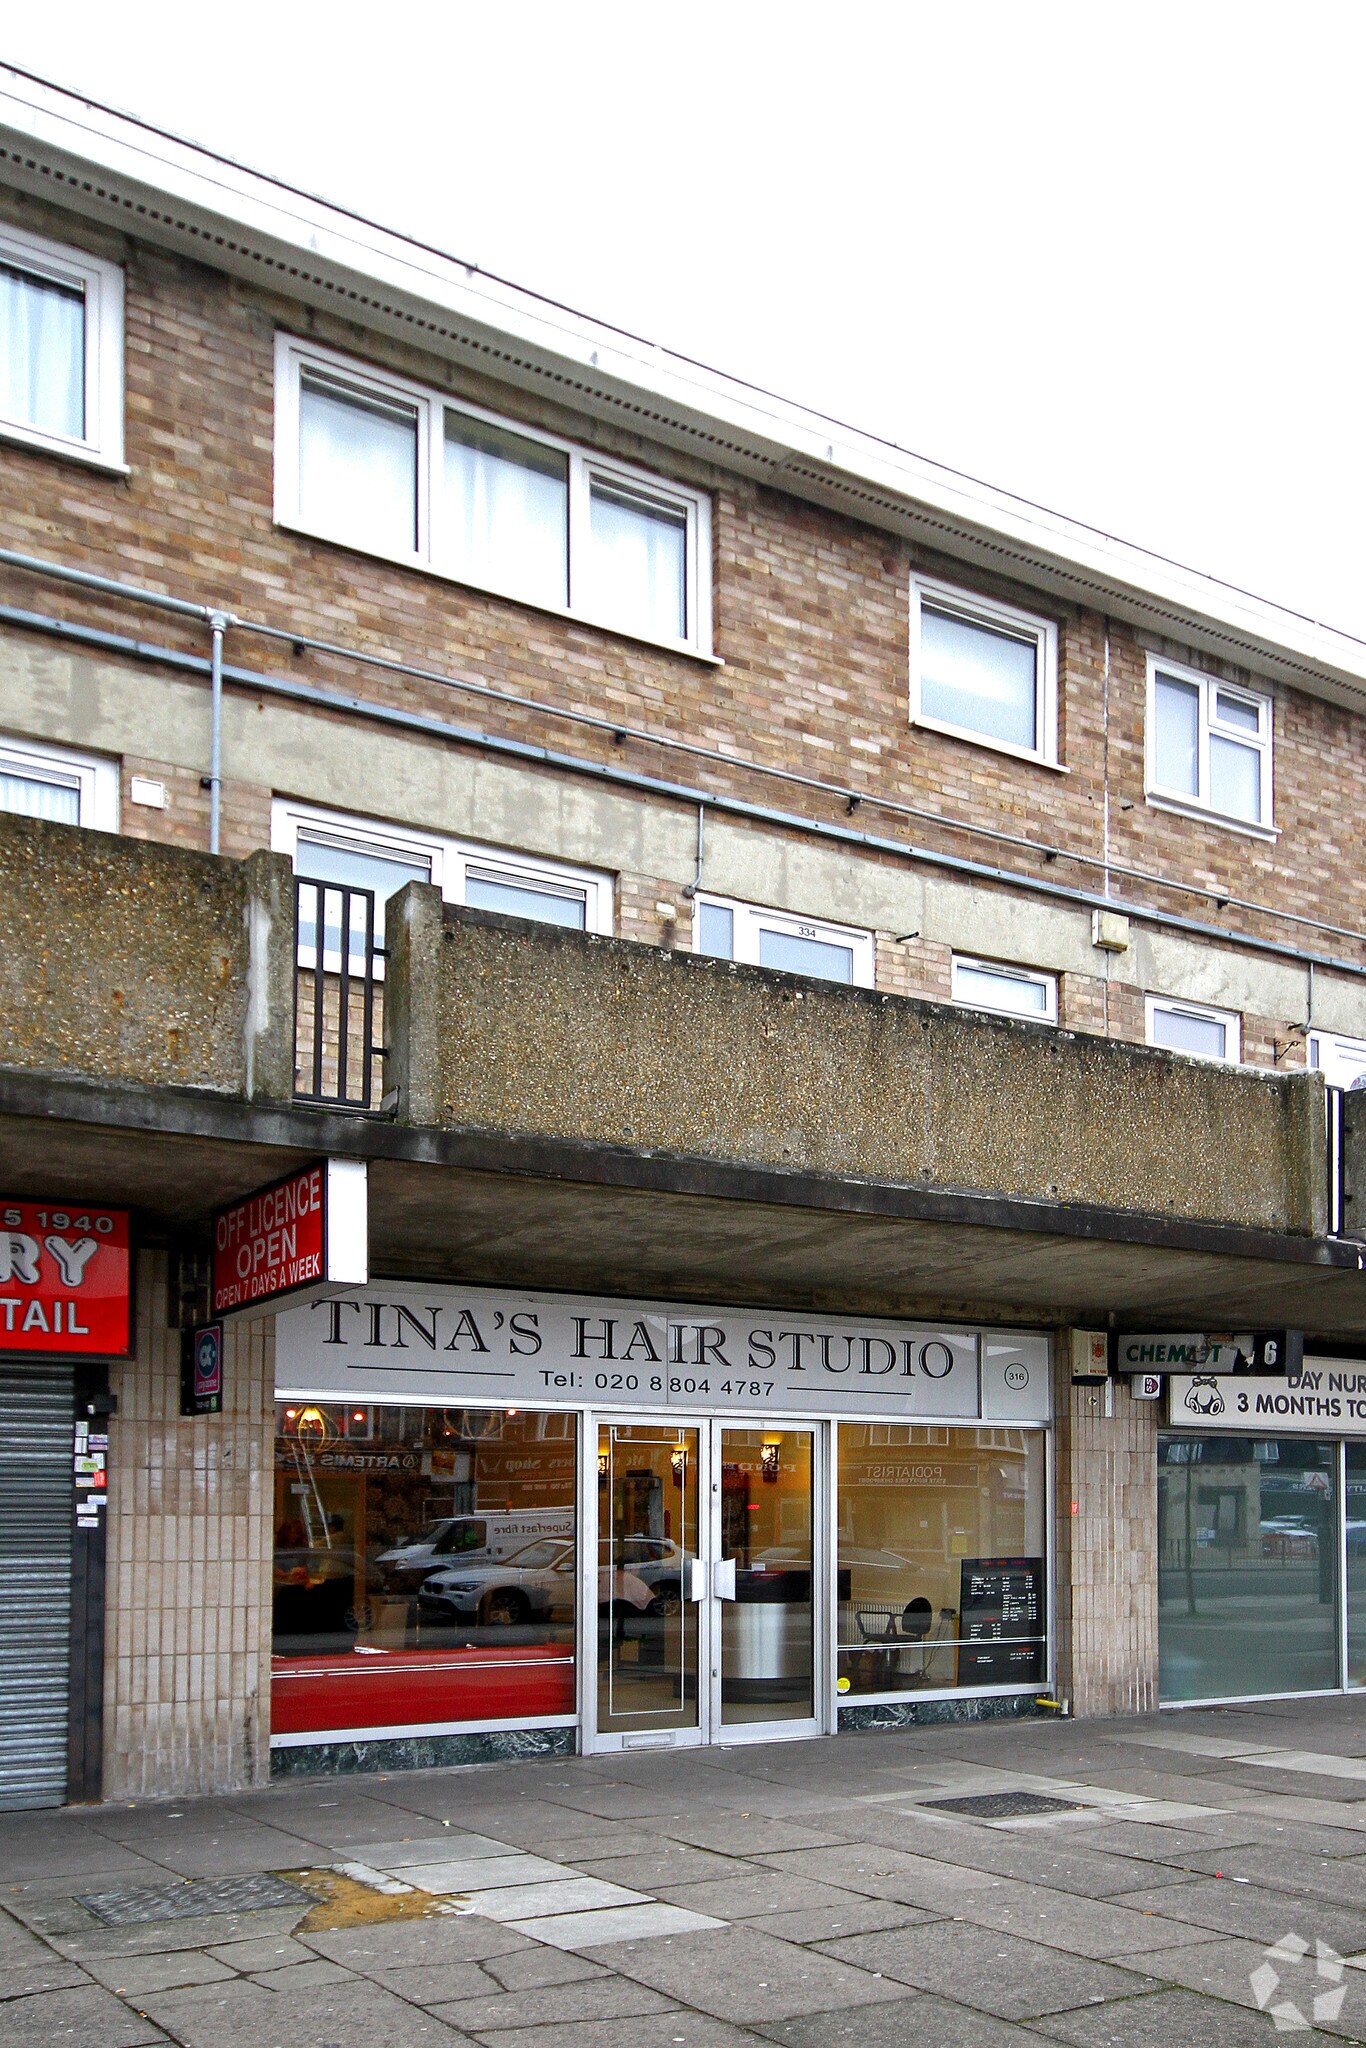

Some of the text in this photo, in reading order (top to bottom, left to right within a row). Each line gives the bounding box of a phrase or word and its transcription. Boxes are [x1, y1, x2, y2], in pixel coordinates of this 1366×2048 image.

[798, 926, 816, 938] 334
[4, 1209, 113, 1234] 5 1940
[217, 1170, 320, 1251] OFF LICENCE
[236, 1223, 296, 1279] OPEN
[215, 1252, 320, 1310] OPEN 7 DAYS A WEEK
[311, 1299, 955, 1379] TINA'S HAIR STUDIO
[1126, 1344, 1222, 1362] CHEMT
[1264, 1340, 1278, 1365] 6
[539, 1370, 775, 1397] Tel: 020 8804 4787
[1008, 1372, 1026, 1382] 316
[1287, 1371, 1323, 1390] DAY
[1237, 1392, 1249, 1413] 3
[1256, 1394, 1342, 1417] MONTHS
